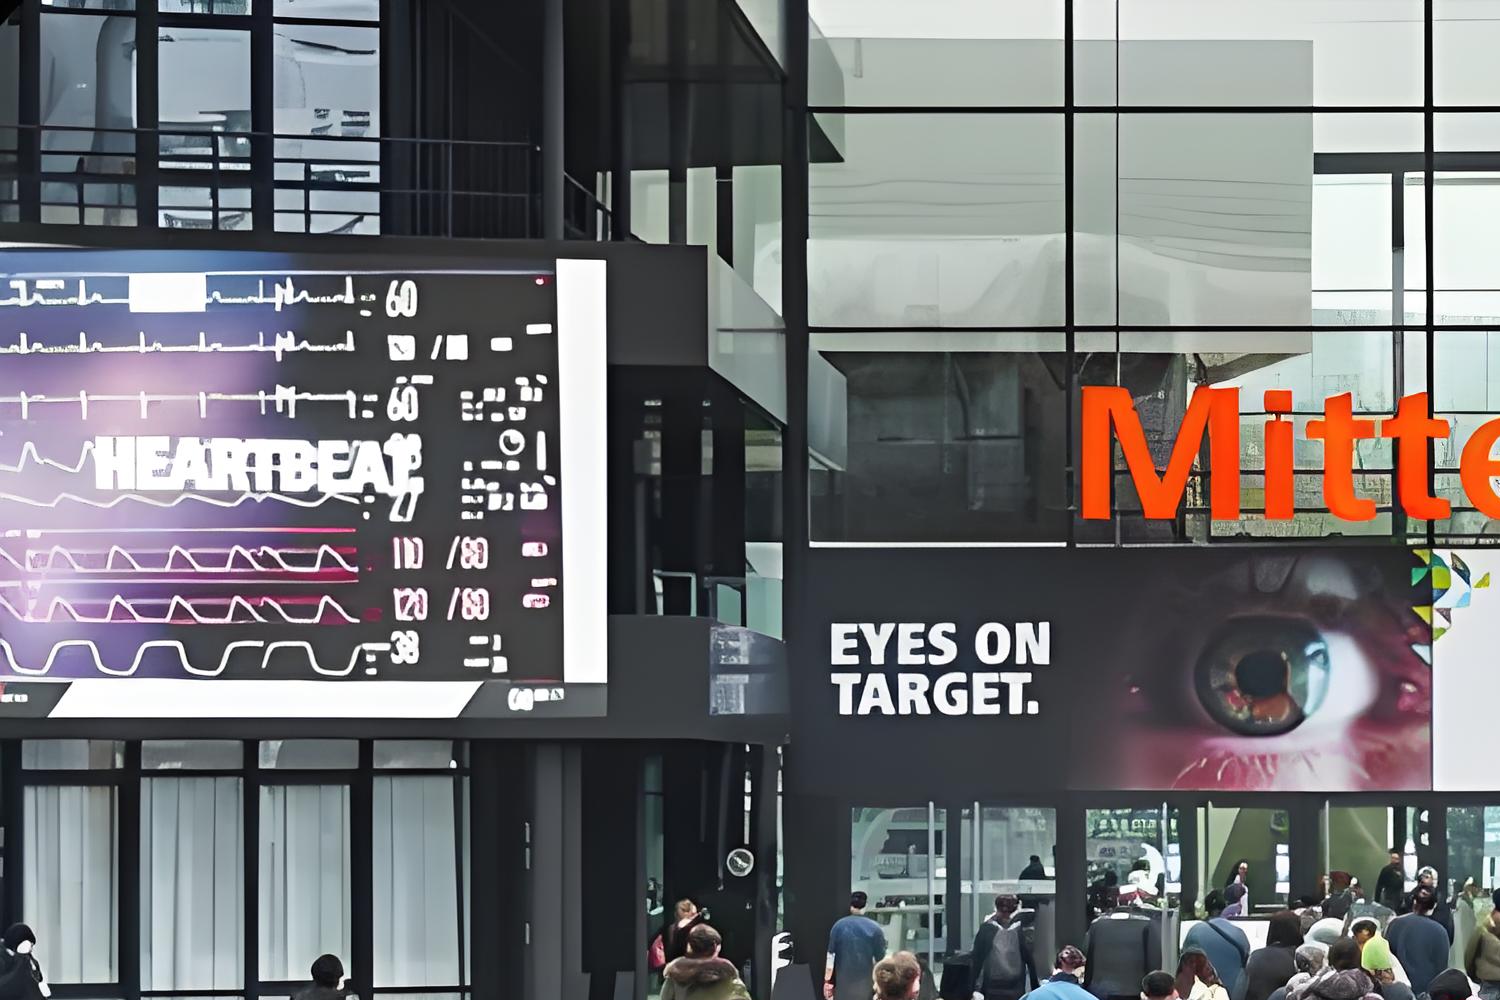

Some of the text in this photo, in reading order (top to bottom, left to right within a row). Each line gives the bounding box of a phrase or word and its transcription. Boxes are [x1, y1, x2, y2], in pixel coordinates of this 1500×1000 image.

[385, 280, 418, 318] 60
[387, 386, 419, 421] 60
[95, 434, 417, 494] HEARTBEAT
[831, 621, 1050, 666] EYES ON
[831, 672, 1039, 717] TARGET.
